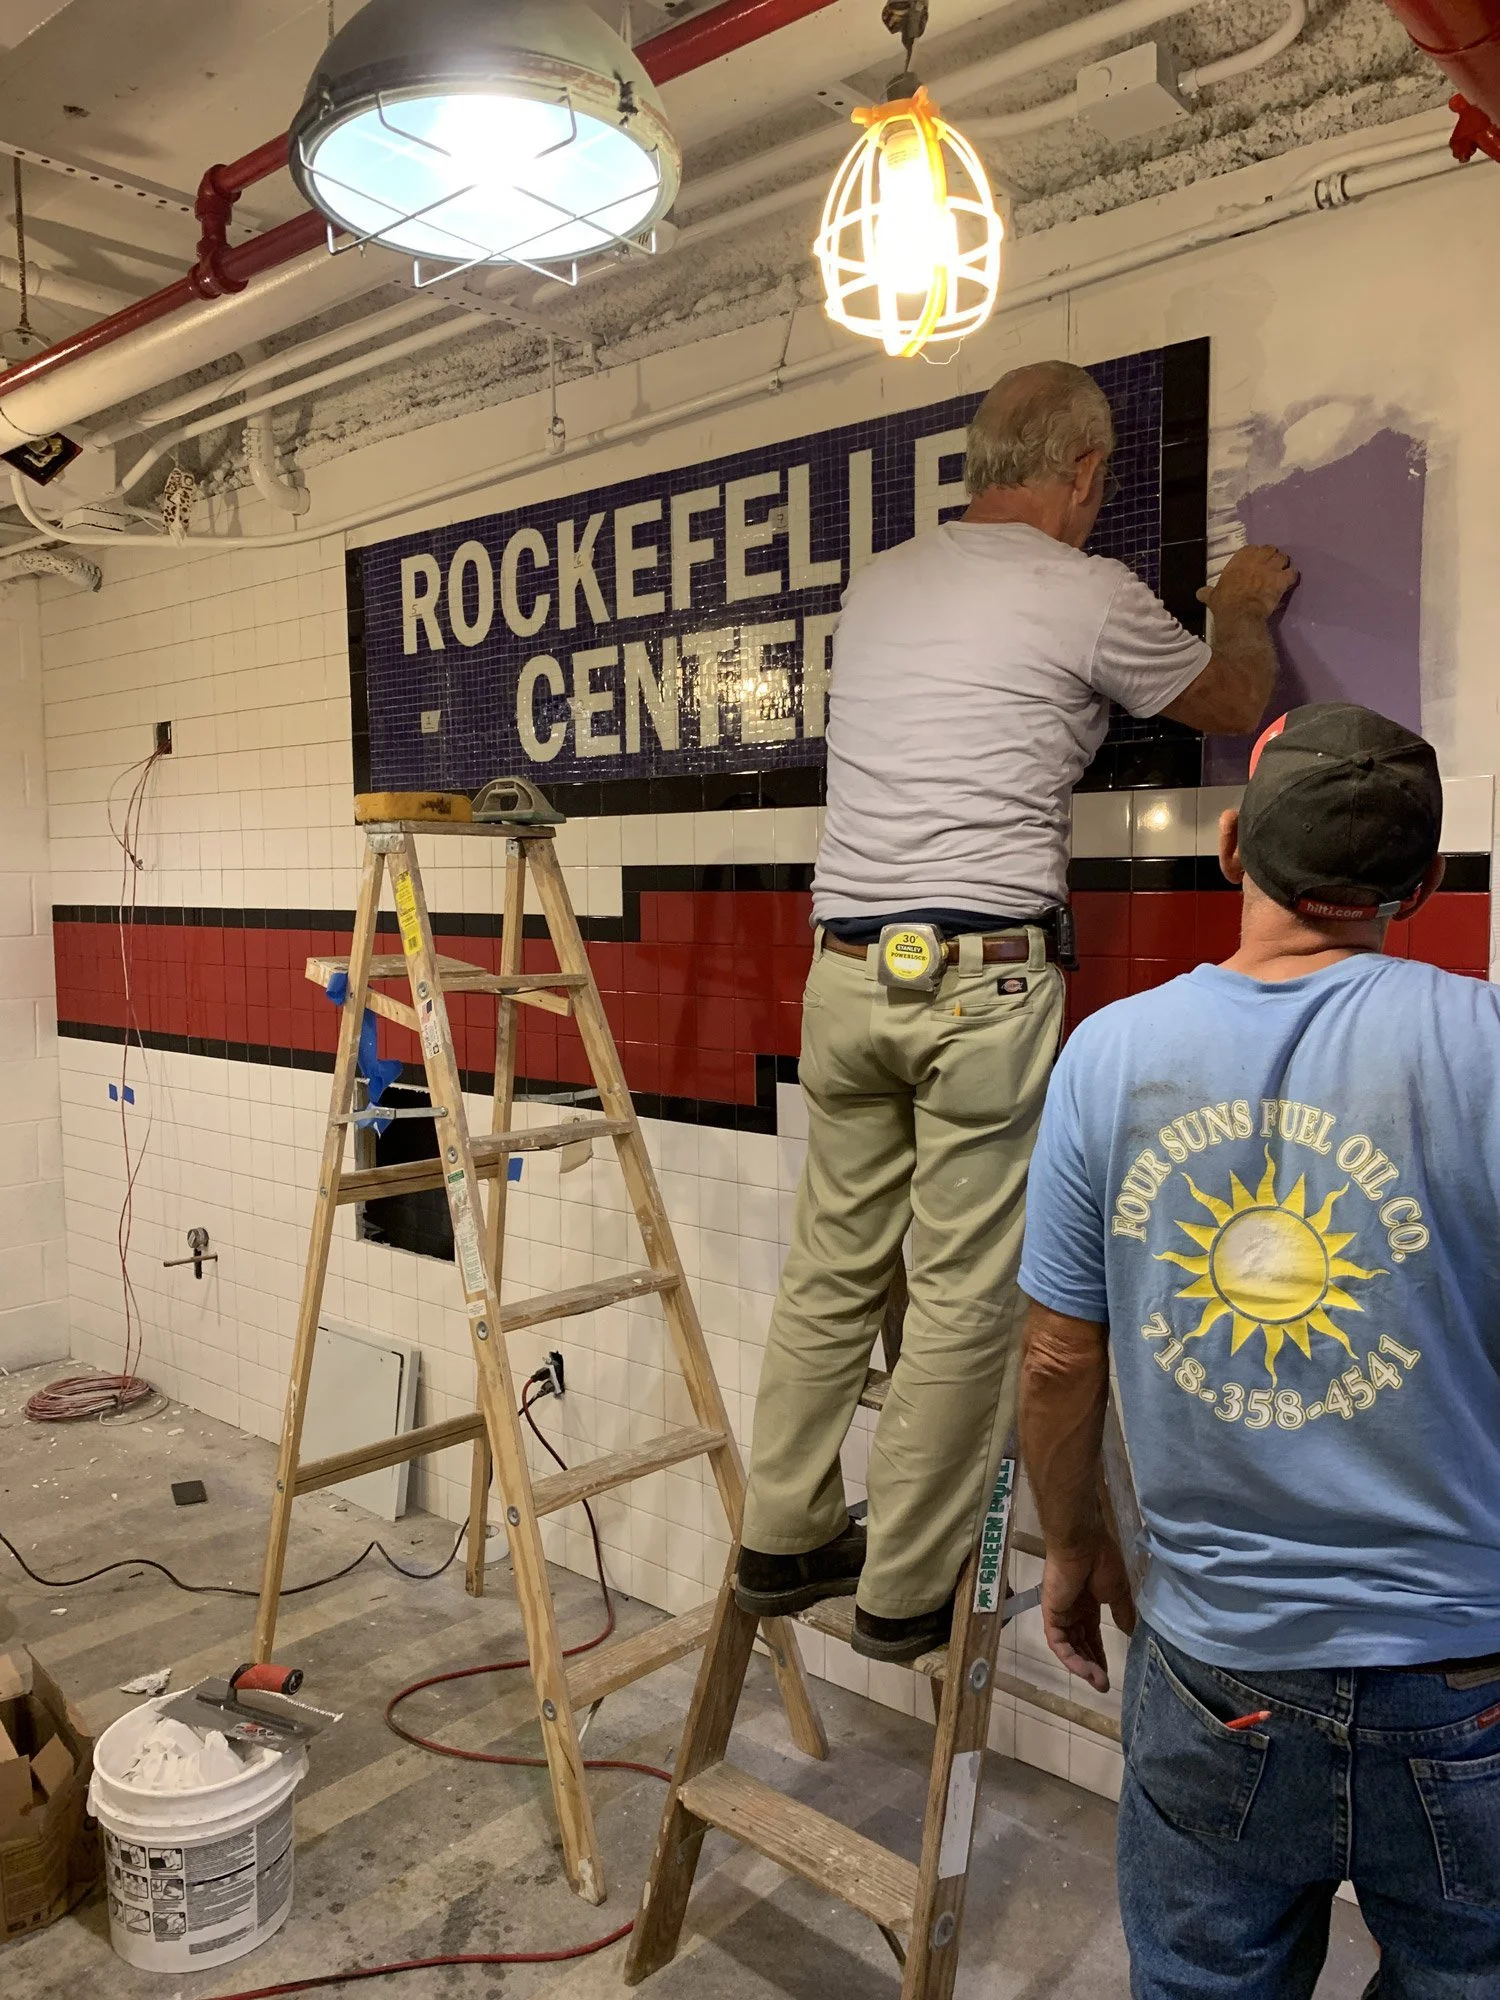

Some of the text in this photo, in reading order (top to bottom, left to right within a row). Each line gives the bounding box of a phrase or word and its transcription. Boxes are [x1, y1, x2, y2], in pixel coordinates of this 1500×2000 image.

[401, 426, 970, 655] ROCKEFELLE
[1306, 902, 1364, 918] hilti.com
[891, 952, 926, 961] POWERLOCK
[896, 944, 922, 953] STANLEY
[1112, 1099, 1430, 1263] FOUR SUNS FUEL OIL CO.
[1141, 1312, 1420, 1430] 718-358-4541
[979, 1516, 1004, 1584] GREEN
